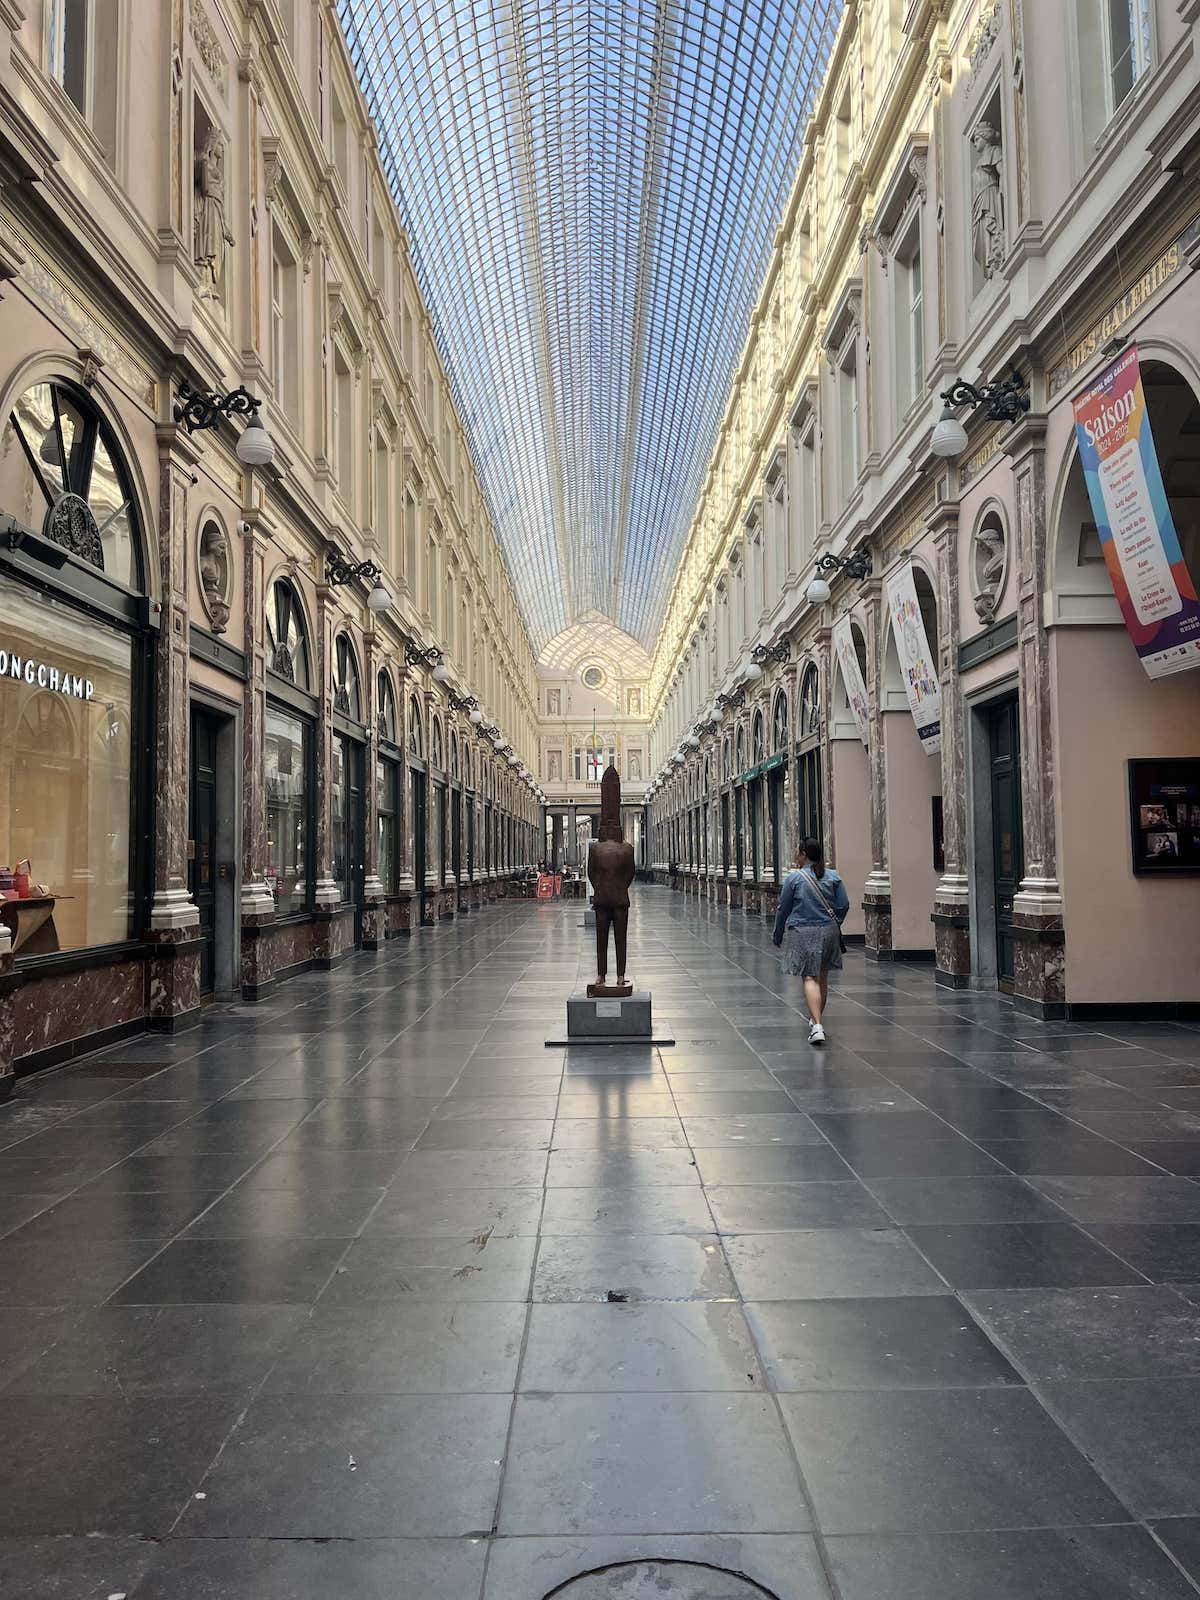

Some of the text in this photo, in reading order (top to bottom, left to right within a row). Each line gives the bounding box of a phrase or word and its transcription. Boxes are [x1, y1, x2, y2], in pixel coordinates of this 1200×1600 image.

[1071, 243, 1178, 373] DES GALERIES
[1103, 374, 1114, 386] DES
[1114, 353, 1136, 377] GALERIES
[1084, 389, 1136, 447] Saison
[0, 650, 94, 700] ONGCHAMP
